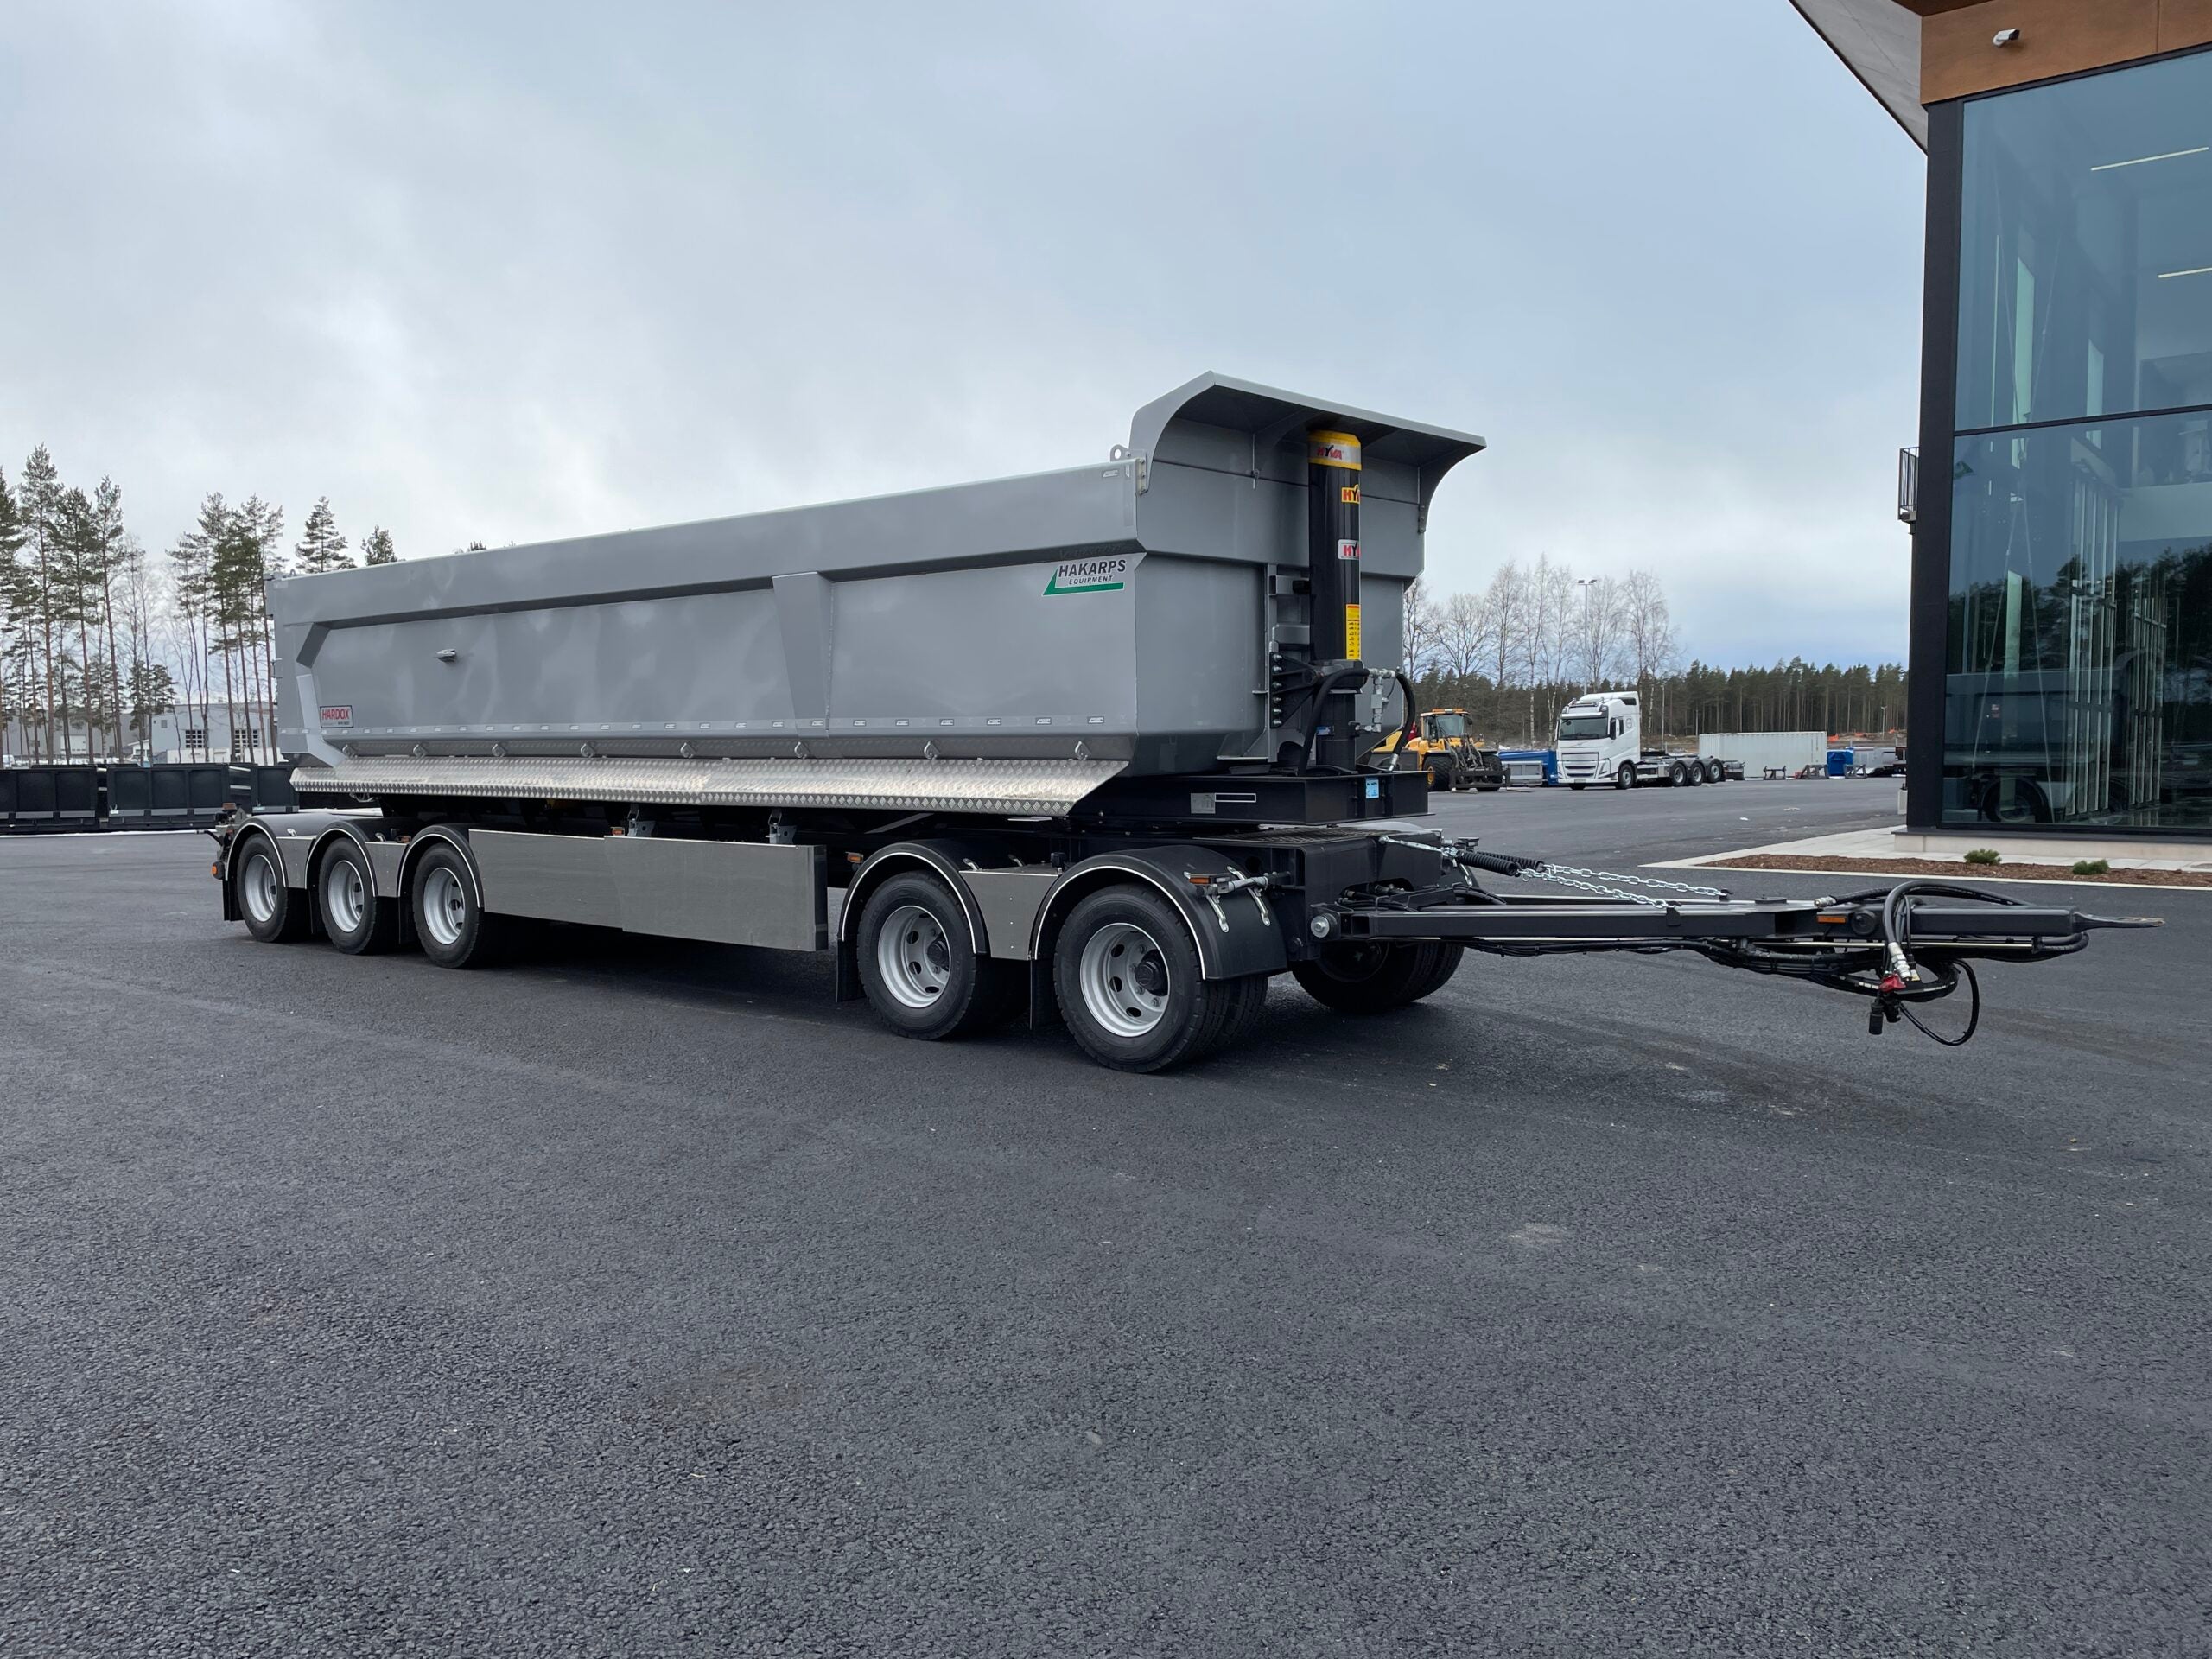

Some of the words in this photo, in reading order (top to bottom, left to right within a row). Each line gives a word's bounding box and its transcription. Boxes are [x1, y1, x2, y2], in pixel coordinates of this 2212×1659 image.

[1058, 559, 1126, 577] HAKARPS
[1069, 575, 1113, 585] EQUIPMENT
[321, 709, 350, 720] HARDOX
